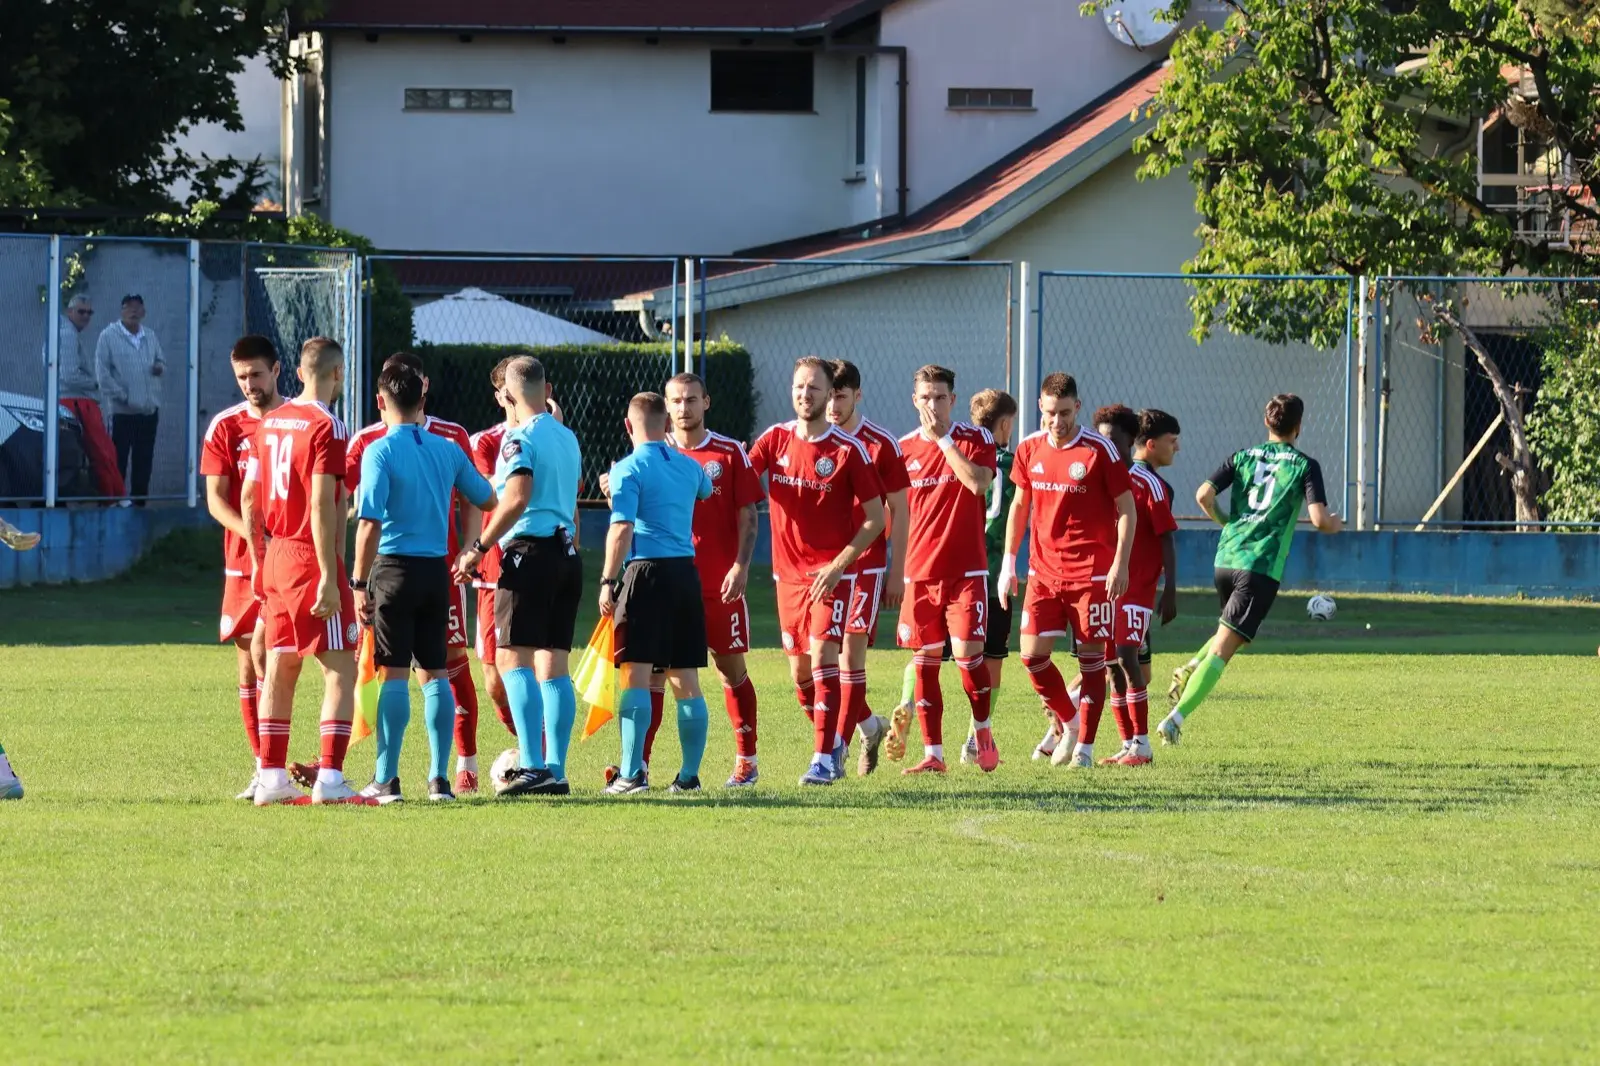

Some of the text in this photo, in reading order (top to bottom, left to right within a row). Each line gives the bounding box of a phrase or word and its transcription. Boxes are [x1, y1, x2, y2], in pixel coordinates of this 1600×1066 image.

[1248, 460, 1279, 511] 5
[832, 599, 844, 623] 8
[855, 591, 868, 615] 7
[975, 601, 984, 623] 9
[1089, 602, 1110, 626] 20
[448, 605, 460, 631] 5
[730, 612, 740, 637] 2
[1123, 607, 1142, 630] 15
